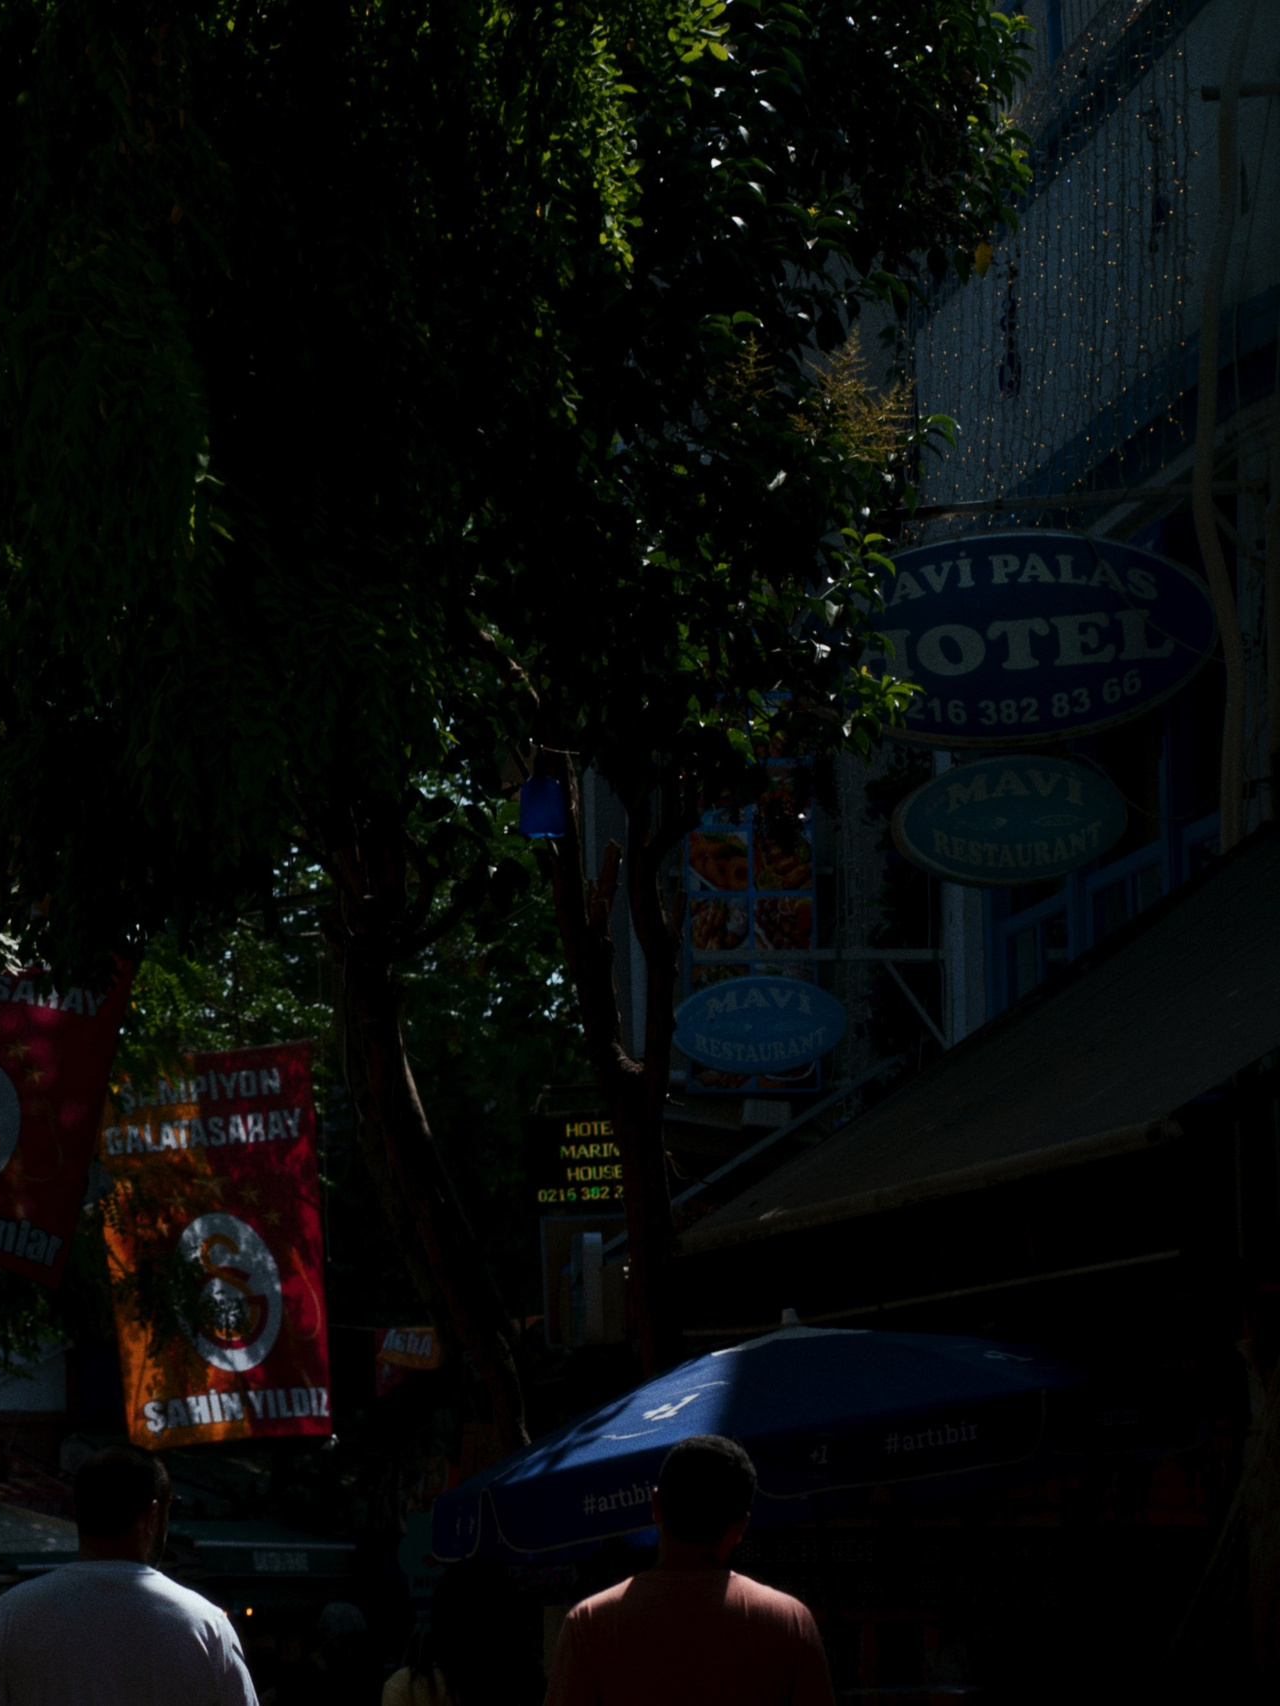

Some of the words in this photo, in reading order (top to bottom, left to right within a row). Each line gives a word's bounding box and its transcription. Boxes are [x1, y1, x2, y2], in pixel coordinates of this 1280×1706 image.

[987, 552, 1160, 602] PALAS
[848, 608, 1177, 683] HOTEL
[905, 694, 968, 727] 216
[978, 696, 1041, 727] 382
[1050, 686, 1093, 720] 83
[1101, 668, 1143, 704] 66
[943, 768, 1085, 815] MAVİ
[932, 820, 1104, 869] RESTAURANT
[705, 986, 813, 1021] MAVİ
[694, 1024, 827, 1063] RESTAURANT
[104, 1107, 303, 1157] GALATASARAY
[564, 1119, 616, 1139] HOTE
[536, 1187, 578, 1204] 0216
[565, 1163, 624, 1183] HOUSE
[143, 1386, 245, 1438] ŞAHİN
[582, 1480, 657, 1516] #artıbi
